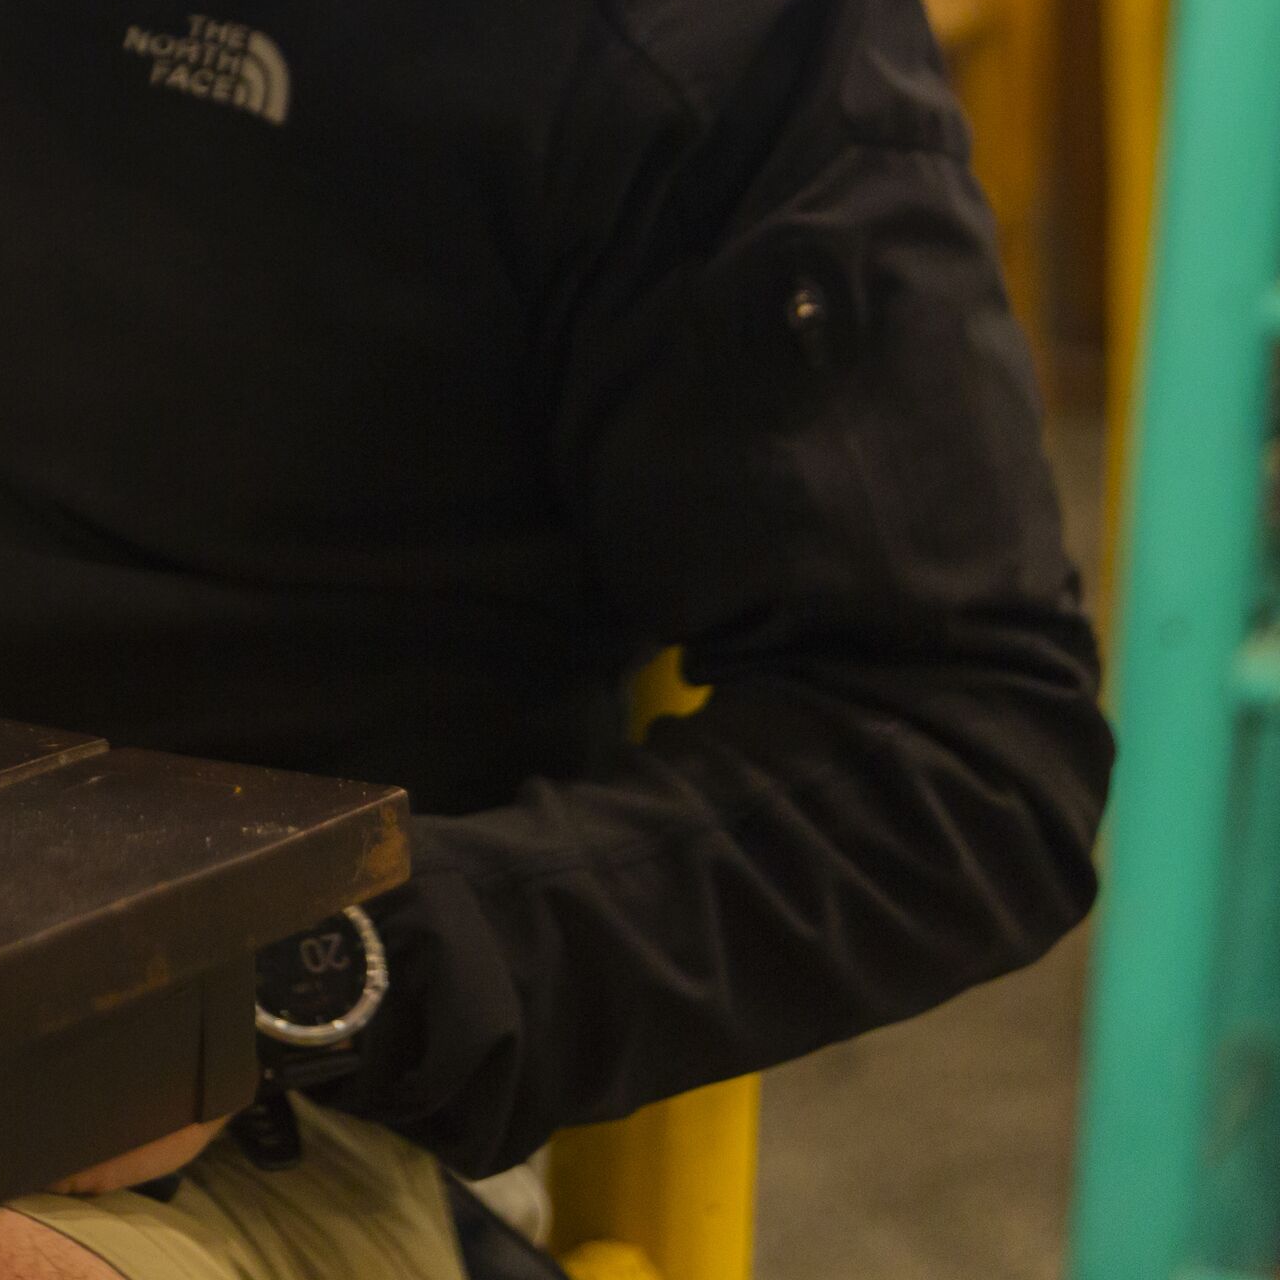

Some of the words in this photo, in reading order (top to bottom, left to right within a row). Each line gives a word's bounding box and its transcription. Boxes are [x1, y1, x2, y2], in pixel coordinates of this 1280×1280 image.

[122, 24, 243, 76] NORTH
[186, 14, 250, 50] THE
[149, 60, 234, 104] FACE
